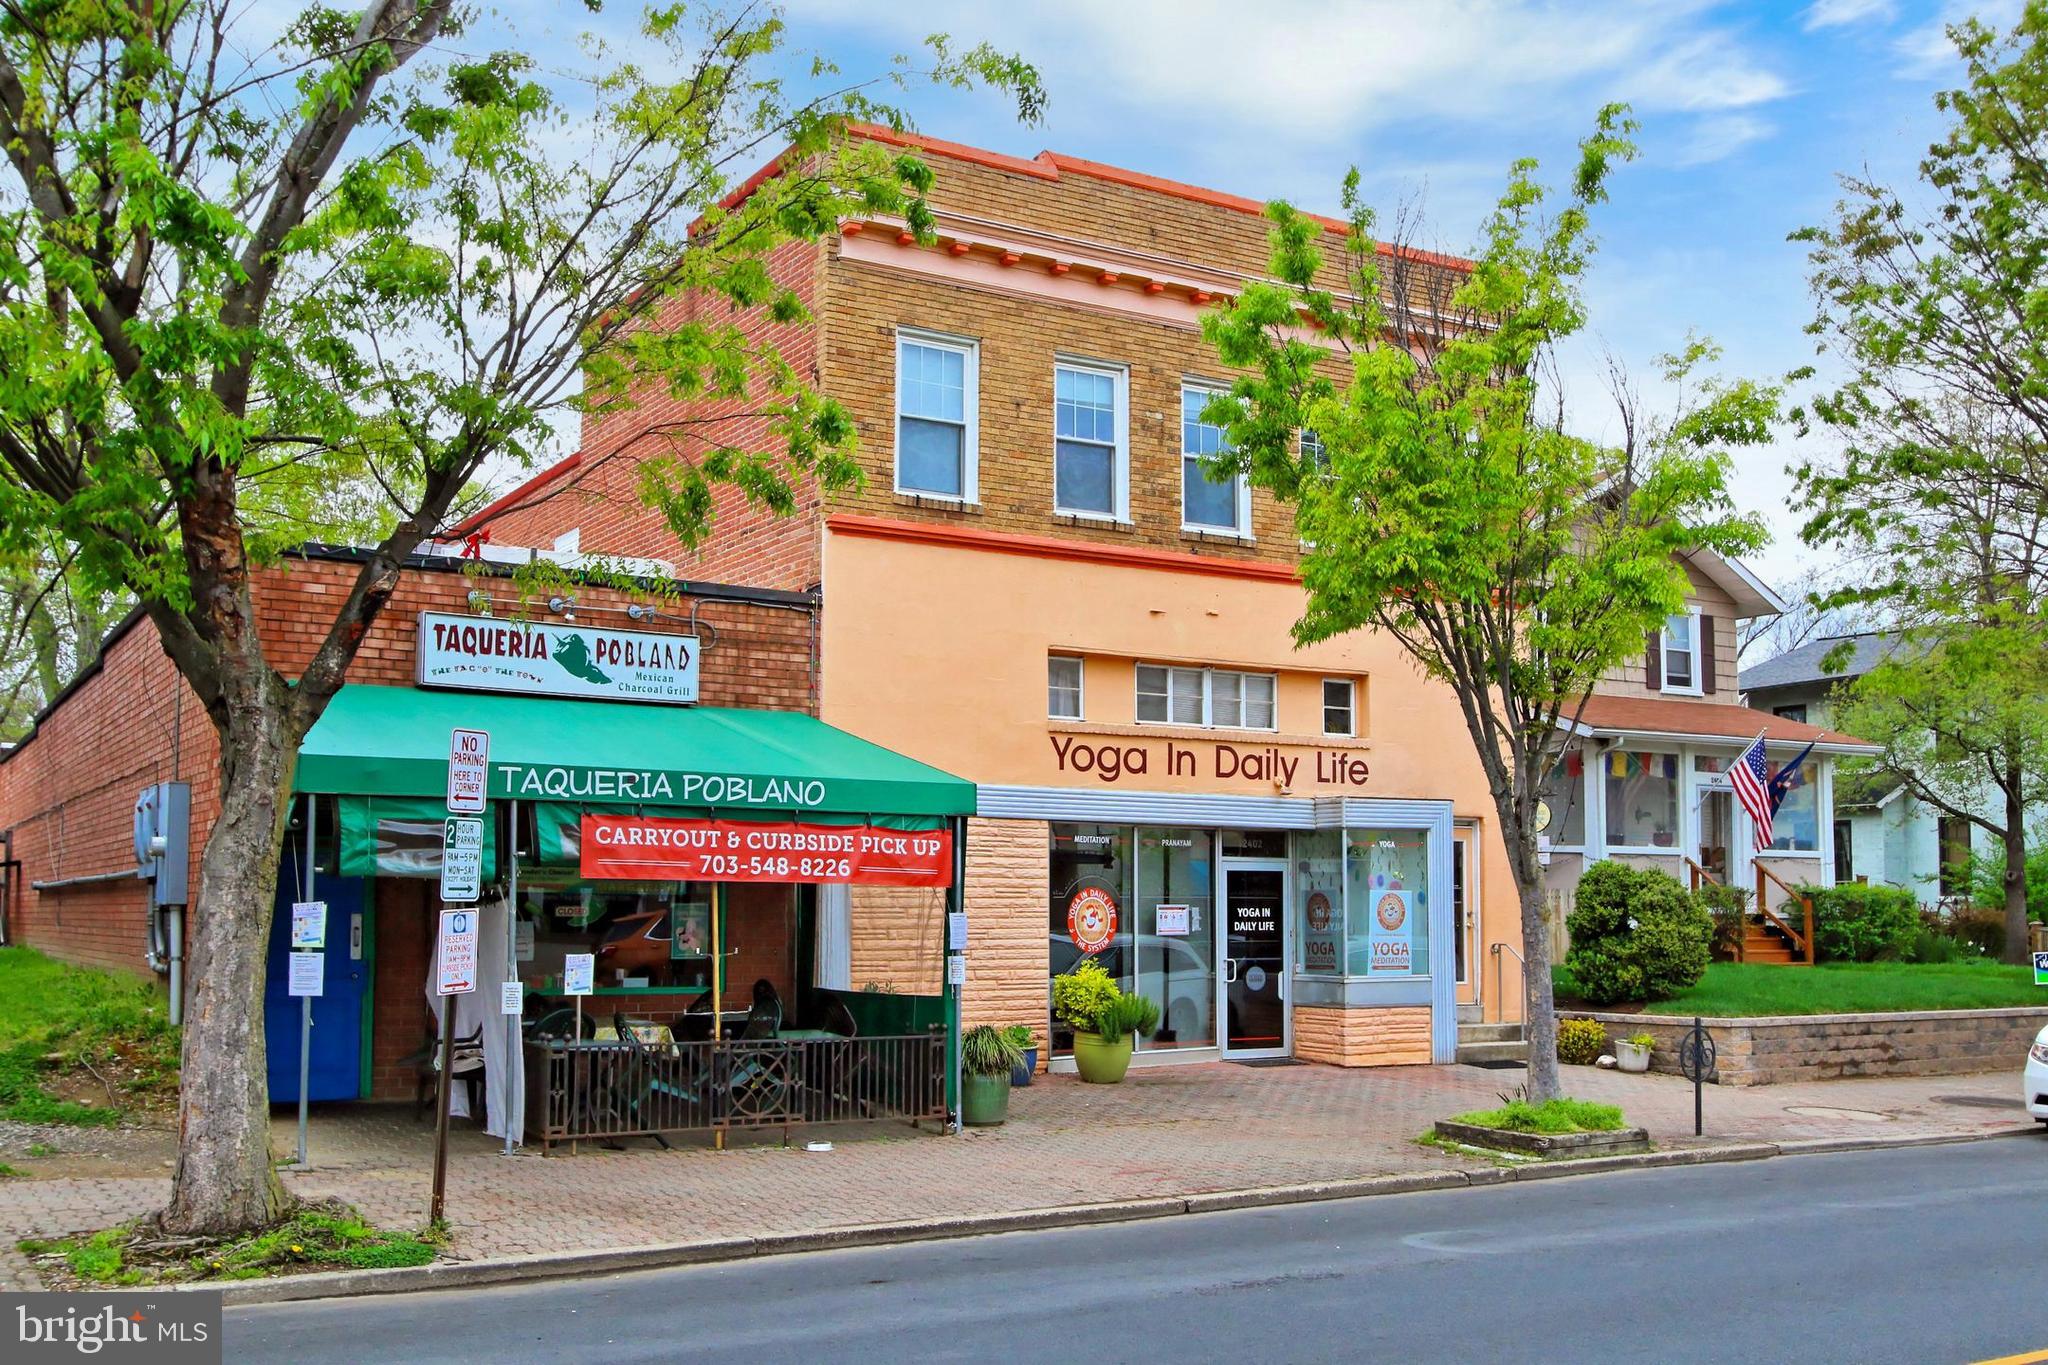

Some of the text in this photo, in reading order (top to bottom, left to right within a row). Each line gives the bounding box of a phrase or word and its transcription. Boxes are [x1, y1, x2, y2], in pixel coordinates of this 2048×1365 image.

[433, 624, 690, 671] TAQUERIA POBLANO
[635, 671, 674, 683] Mexican
[618, 682, 690, 696] Charcoal Grill
[462, 737, 477, 752] NO
[453, 752, 484, 767] PARKING
[1050, 737, 1369, 787] Yoga In Daily Life
[453, 770, 482, 782] HERE TO
[454, 782, 480, 793] CORNER
[498, 766, 826, 806] TAQUERIA POBLANO
[447, 824, 455, 844] 2
[457, 824, 474, 834] HOUR
[457, 835, 480, 846] PARKING
[595, 826, 941, 857] CARRYOUT & CURBSIDE PICK UP
[1074, 835, 1110, 845] MEDITATION
[1161, 839, 1192, 847] PRANAYAM
[448, 865, 475, 875] MON-SAT
[700, 855, 850, 877] 703-548-8226
[1069, 890, 1117, 919] YOGA IN DAILY LIFE
[1237, 908, 1271, 918] YOGA IN
[1234, 922, 1275, 931] DAILY LIFE
[445, 933, 473, 944] RESERVED
[1076, 937, 1110, 952] THE SYSTEM
[446, 944, 471, 953] PARKING
[1305, 941, 1335, 956] YOGA
[1373, 942, 1409, 956] YOGA
